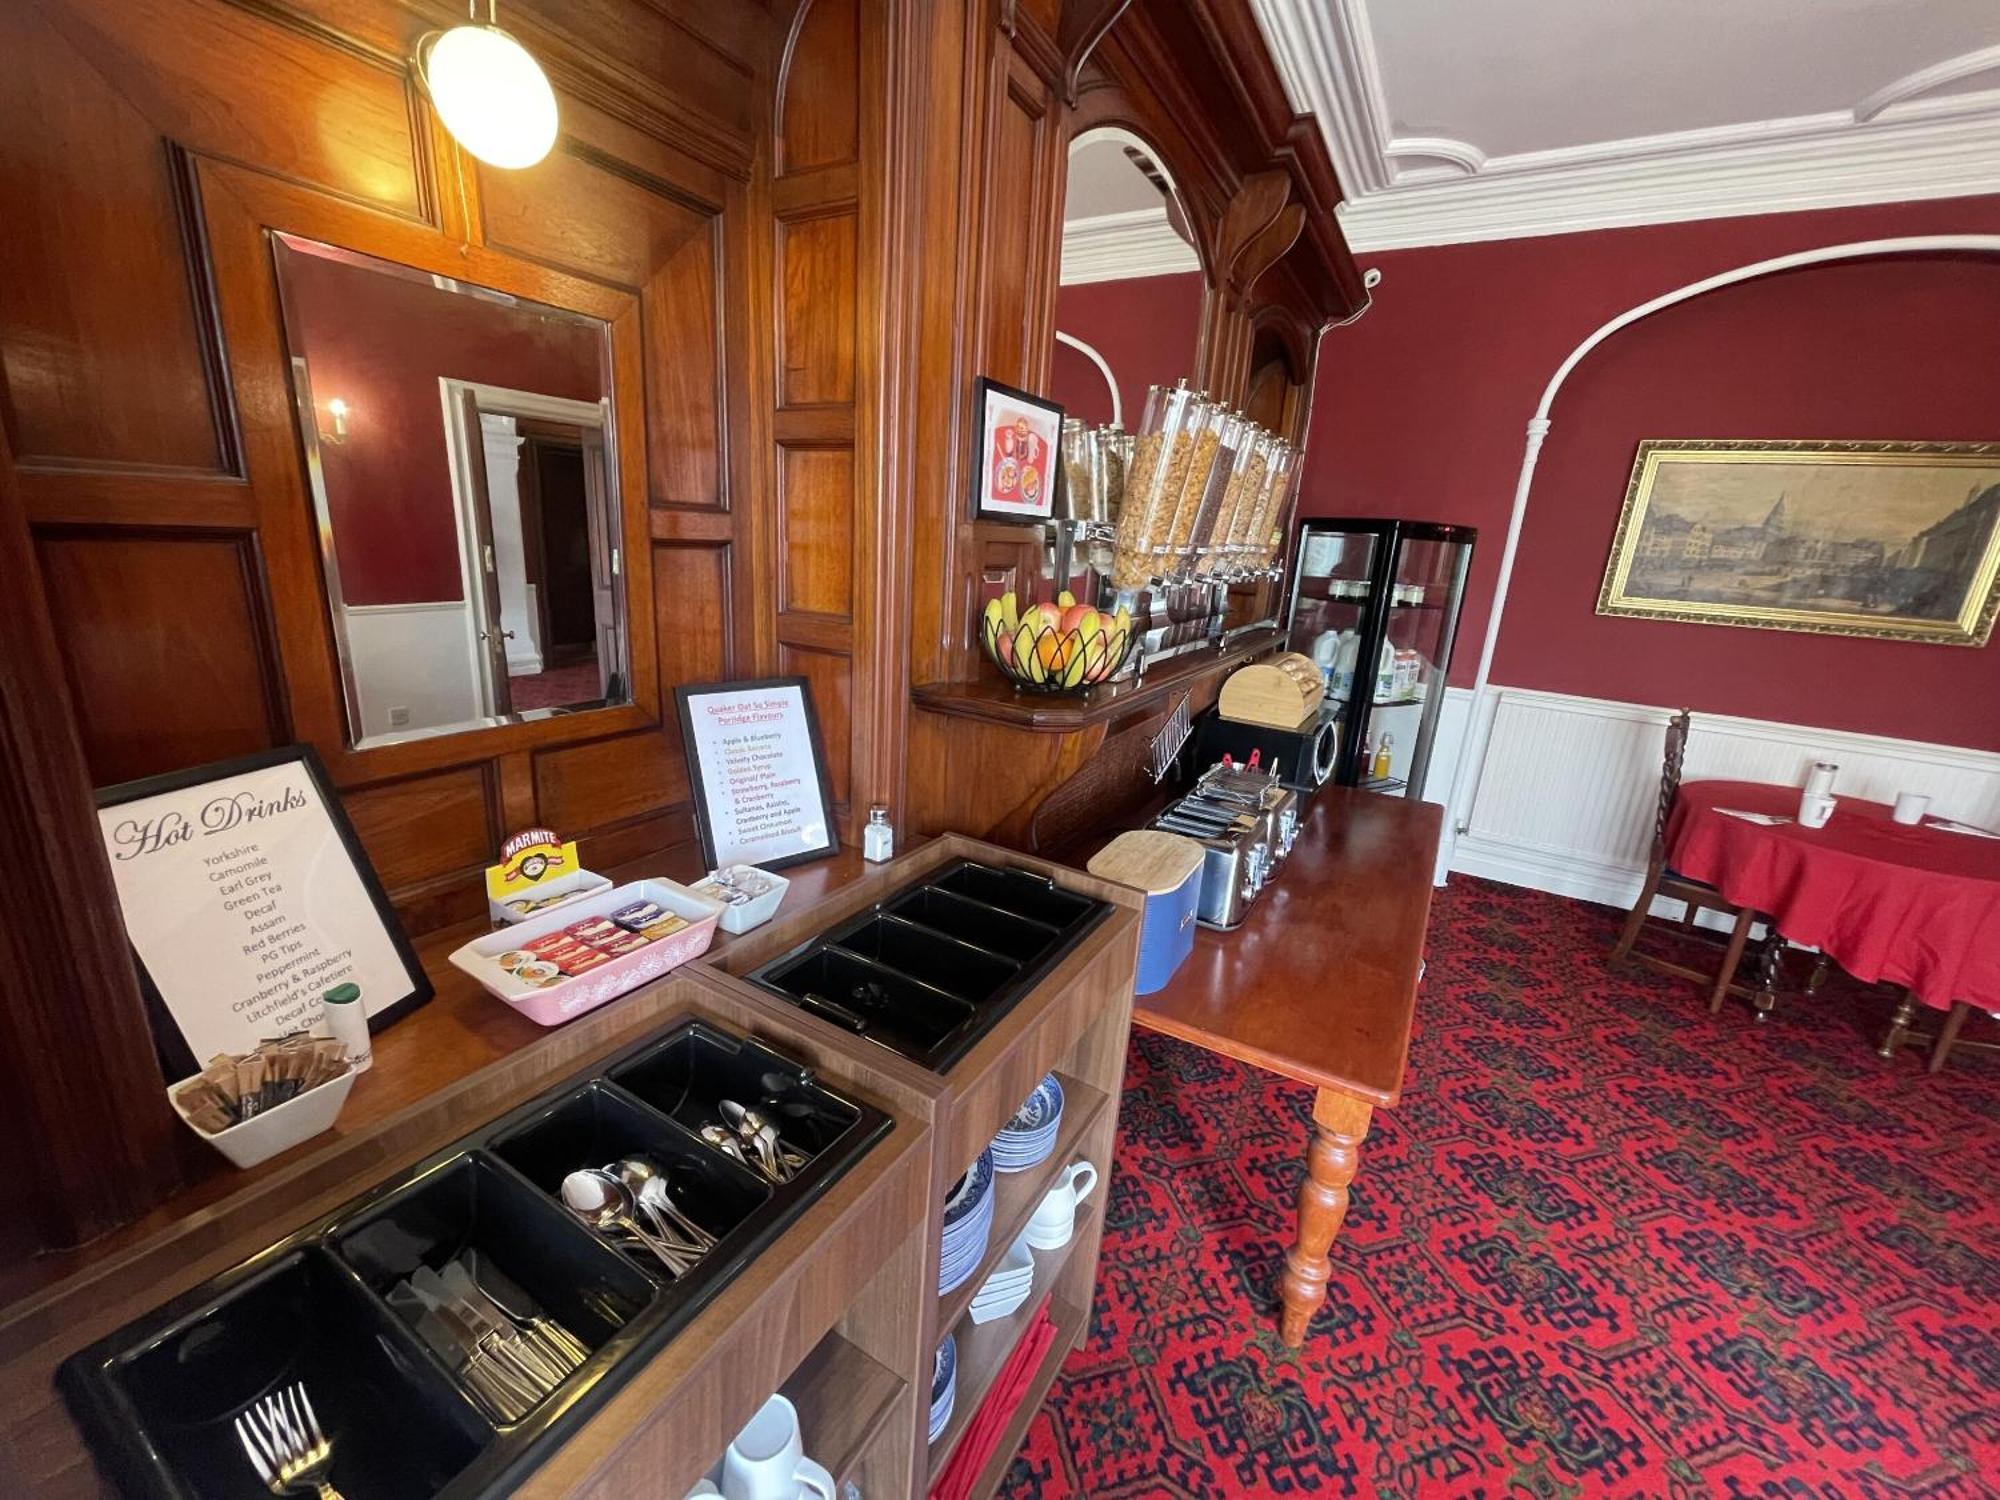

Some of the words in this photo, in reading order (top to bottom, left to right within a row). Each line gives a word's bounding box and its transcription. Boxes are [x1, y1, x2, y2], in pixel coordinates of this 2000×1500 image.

[707, 705, 735, 715] Quaker
[752, 701, 763, 711] So
[763, 699, 788, 709] Simple
[719, 716, 750, 725] Porridge
[752, 711, 783, 721] Flavours
[750, 732, 782, 741] Blueberry
[726, 757, 750, 765] Velvety
[751, 751, 783, 761] Chocolate
[770, 778, 801, 788] Raspberry
[741, 793, 773, 803] Cranberry
[734, 805, 764, 815] Sultanas,
[736, 814, 768, 825] Cranberry
[770, 810, 782, 818] and
[783, 808, 801, 816] Apple
[113, 812, 194, 861] Hot
[200, 787, 307, 836] Drinks
[738, 826, 758, 835] Sweet
[203, 844, 259, 867] Yorkshire
[506, 831, 556, 858] MARMITE
[209, 857, 268, 882] Camomile
[220, 880, 243, 895] Earl
[244, 872, 272, 886] Grey
[223, 892, 261, 911] Green
[261, 884, 282, 896] Tea
[244, 900, 276, 920] Decaf
[250, 915, 286, 935] Assam
[243, 939, 267, 955] Red
[267, 923, 307, 944] Berries
[261, 950, 279, 964] PG
[279, 941, 303, 955] Tips
[256, 948, 321, 983] Peppermint
[232, 980, 289, 1012] Cranberry
[292, 974, 302, 984] &
[302, 949, 352, 978] Raspberry
[246, 988, 308, 1024] Litchfield's
[307, 965, 353, 992] Cafetiere
[275, 1003, 308, 1026] Decaf
